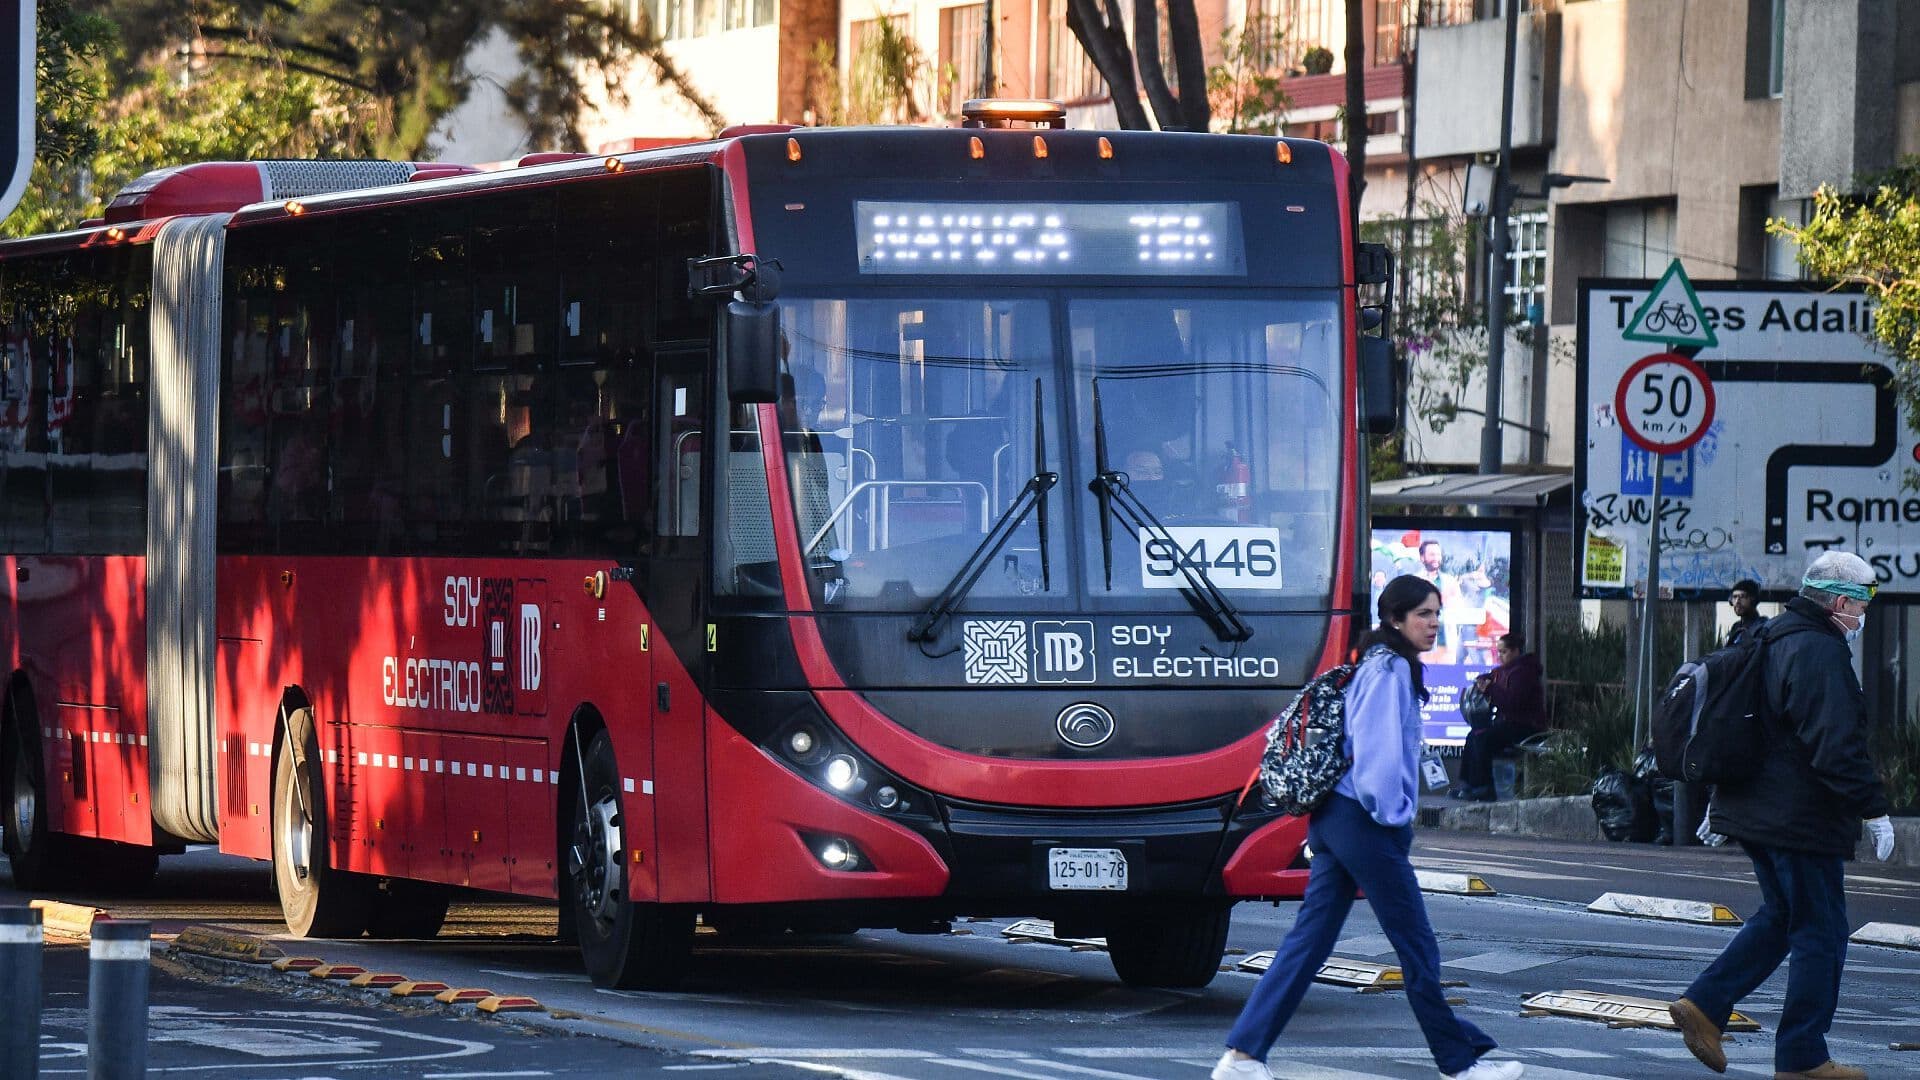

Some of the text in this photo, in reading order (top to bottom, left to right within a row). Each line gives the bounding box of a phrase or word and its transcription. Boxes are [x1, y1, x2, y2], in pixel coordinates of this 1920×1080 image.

[1642, 373, 1692, 418] 50
[1642, 420, 1688, 434] km/h
[1806, 488, 1920, 522] Rome
[1145, 538, 1278, 577] 9446
[444, 575, 481, 627] SOY
[1111, 625, 1172, 646] SOY
[383, 635, 481, 713] ELÉCTRICO
[1111, 648, 1280, 678] ELÉCTRICO
[1053, 861, 1125, 878] 125-01-78
